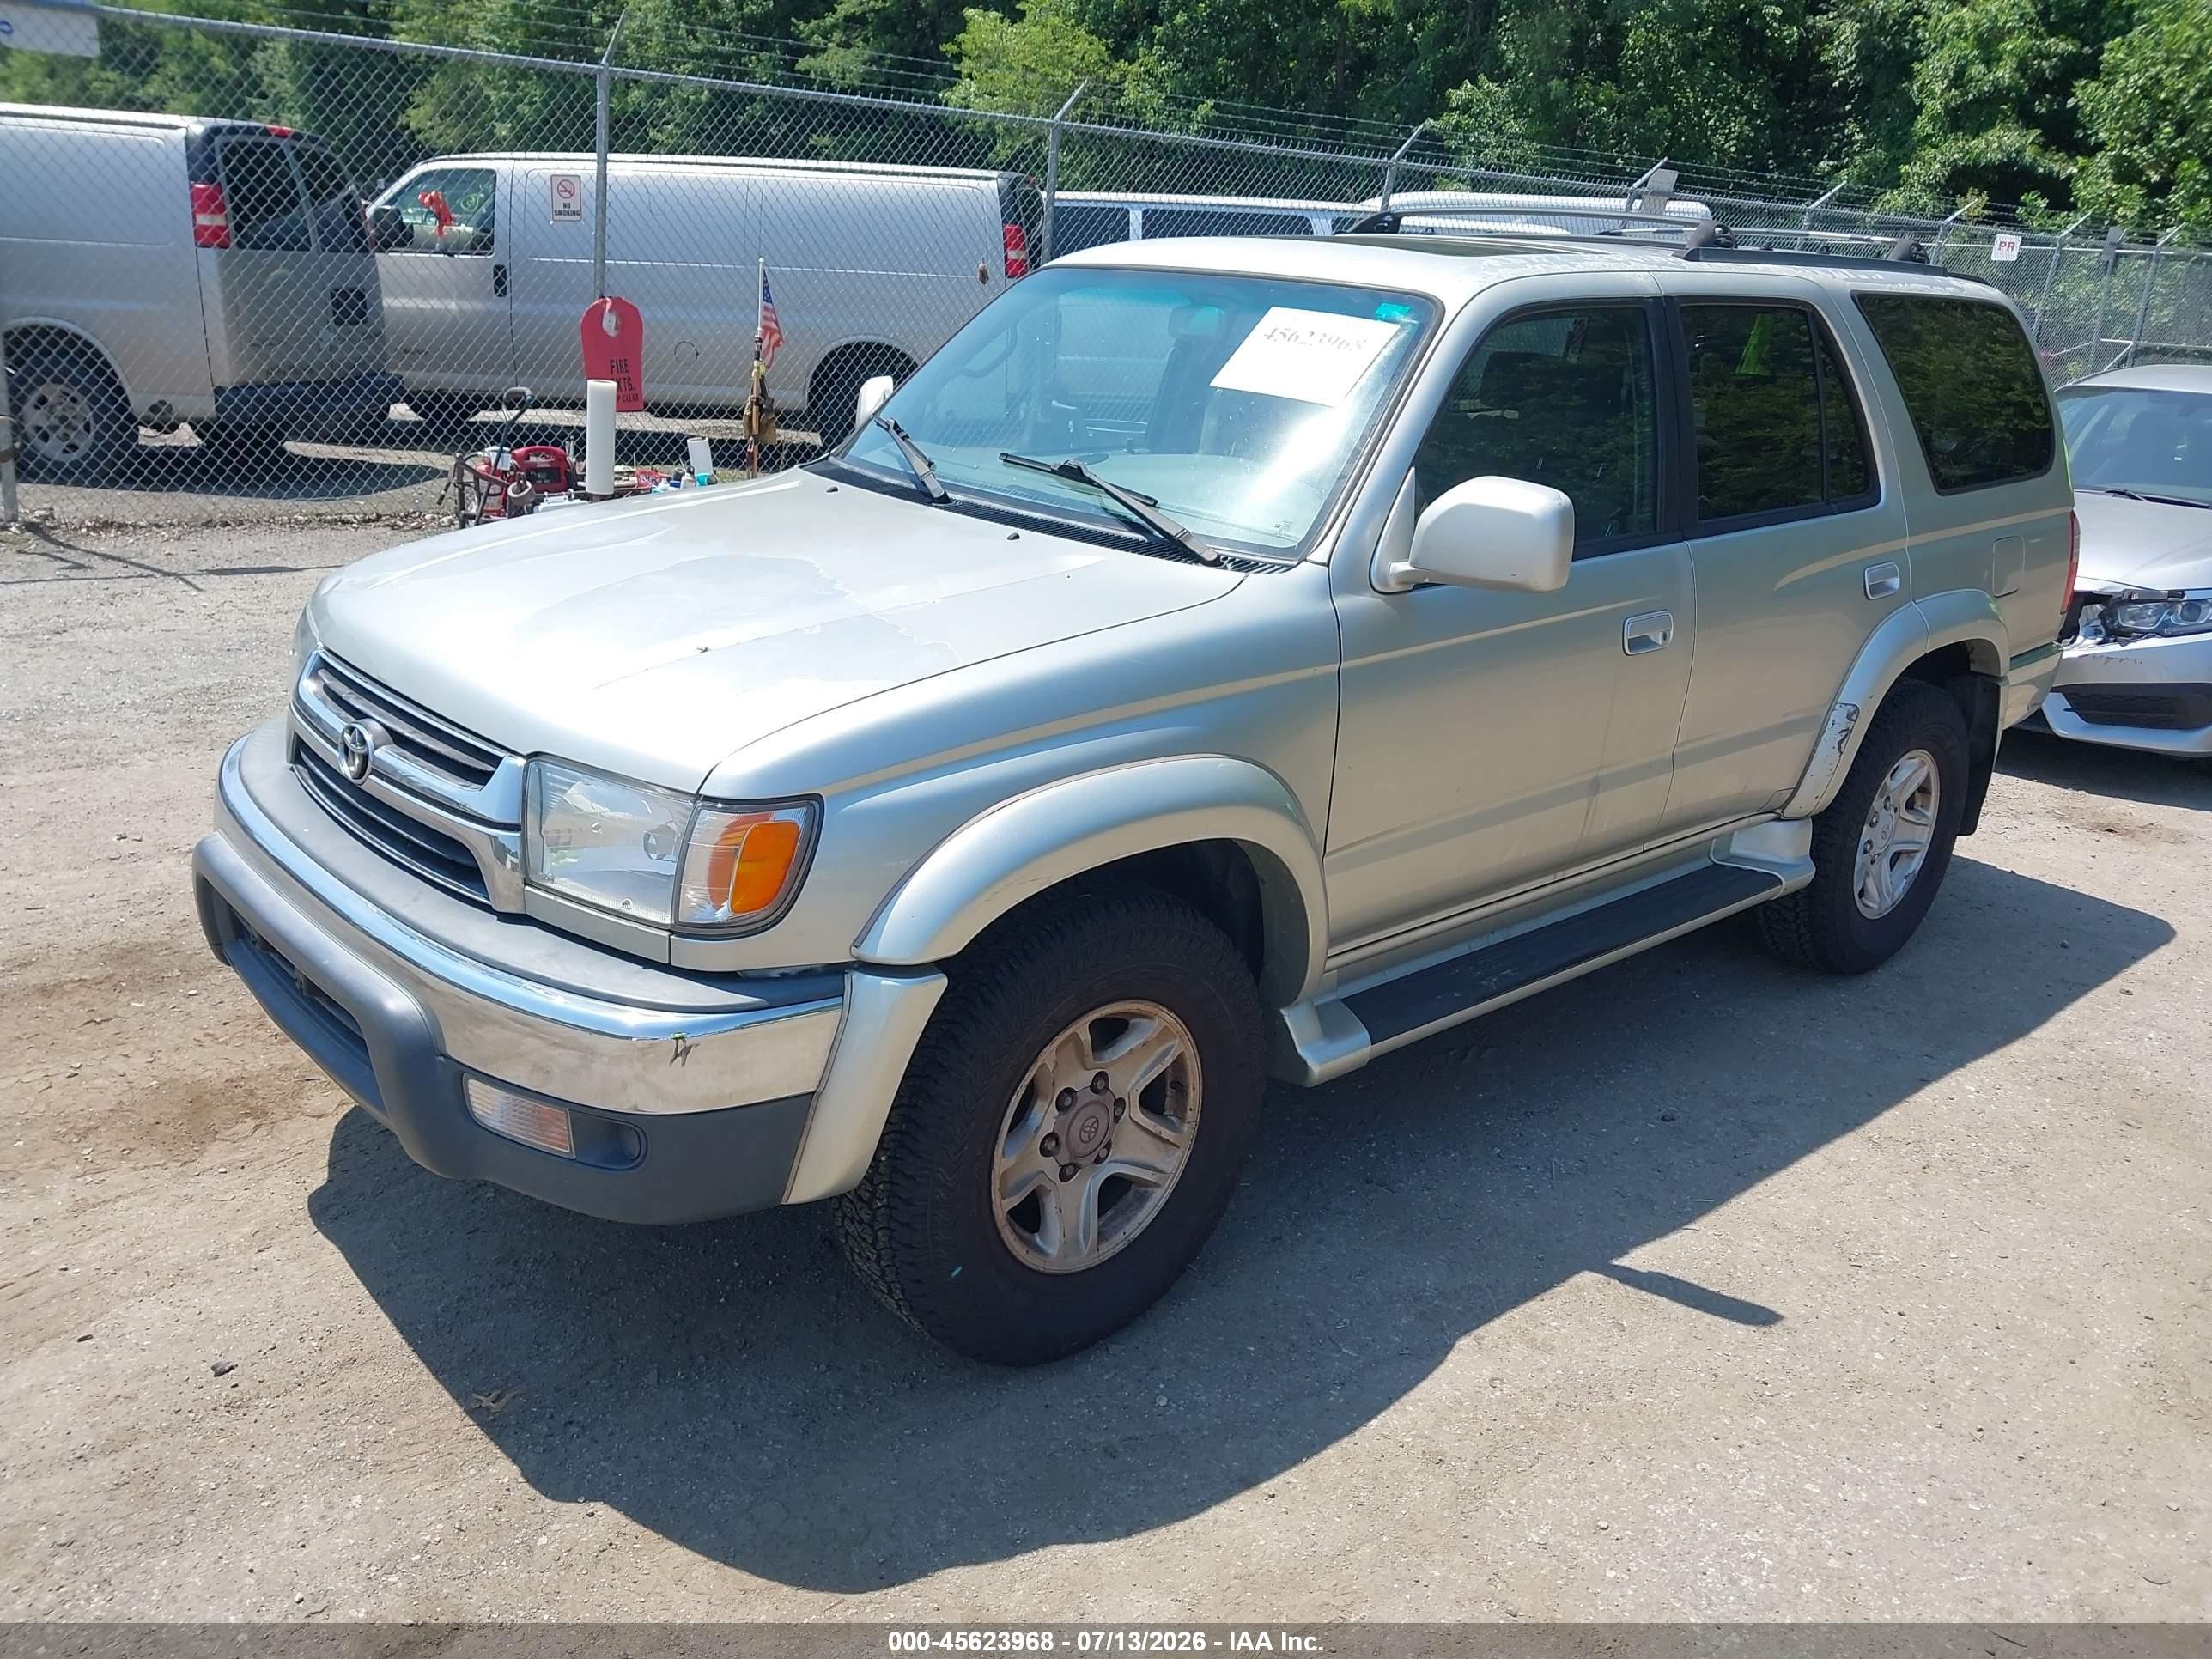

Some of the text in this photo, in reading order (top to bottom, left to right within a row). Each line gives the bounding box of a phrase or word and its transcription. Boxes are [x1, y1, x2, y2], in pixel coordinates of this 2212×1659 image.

[1998, 240, 2015, 251] PR
[610, 359, 629, 374] FIRE
[611, 376, 636, 392] XTG.
